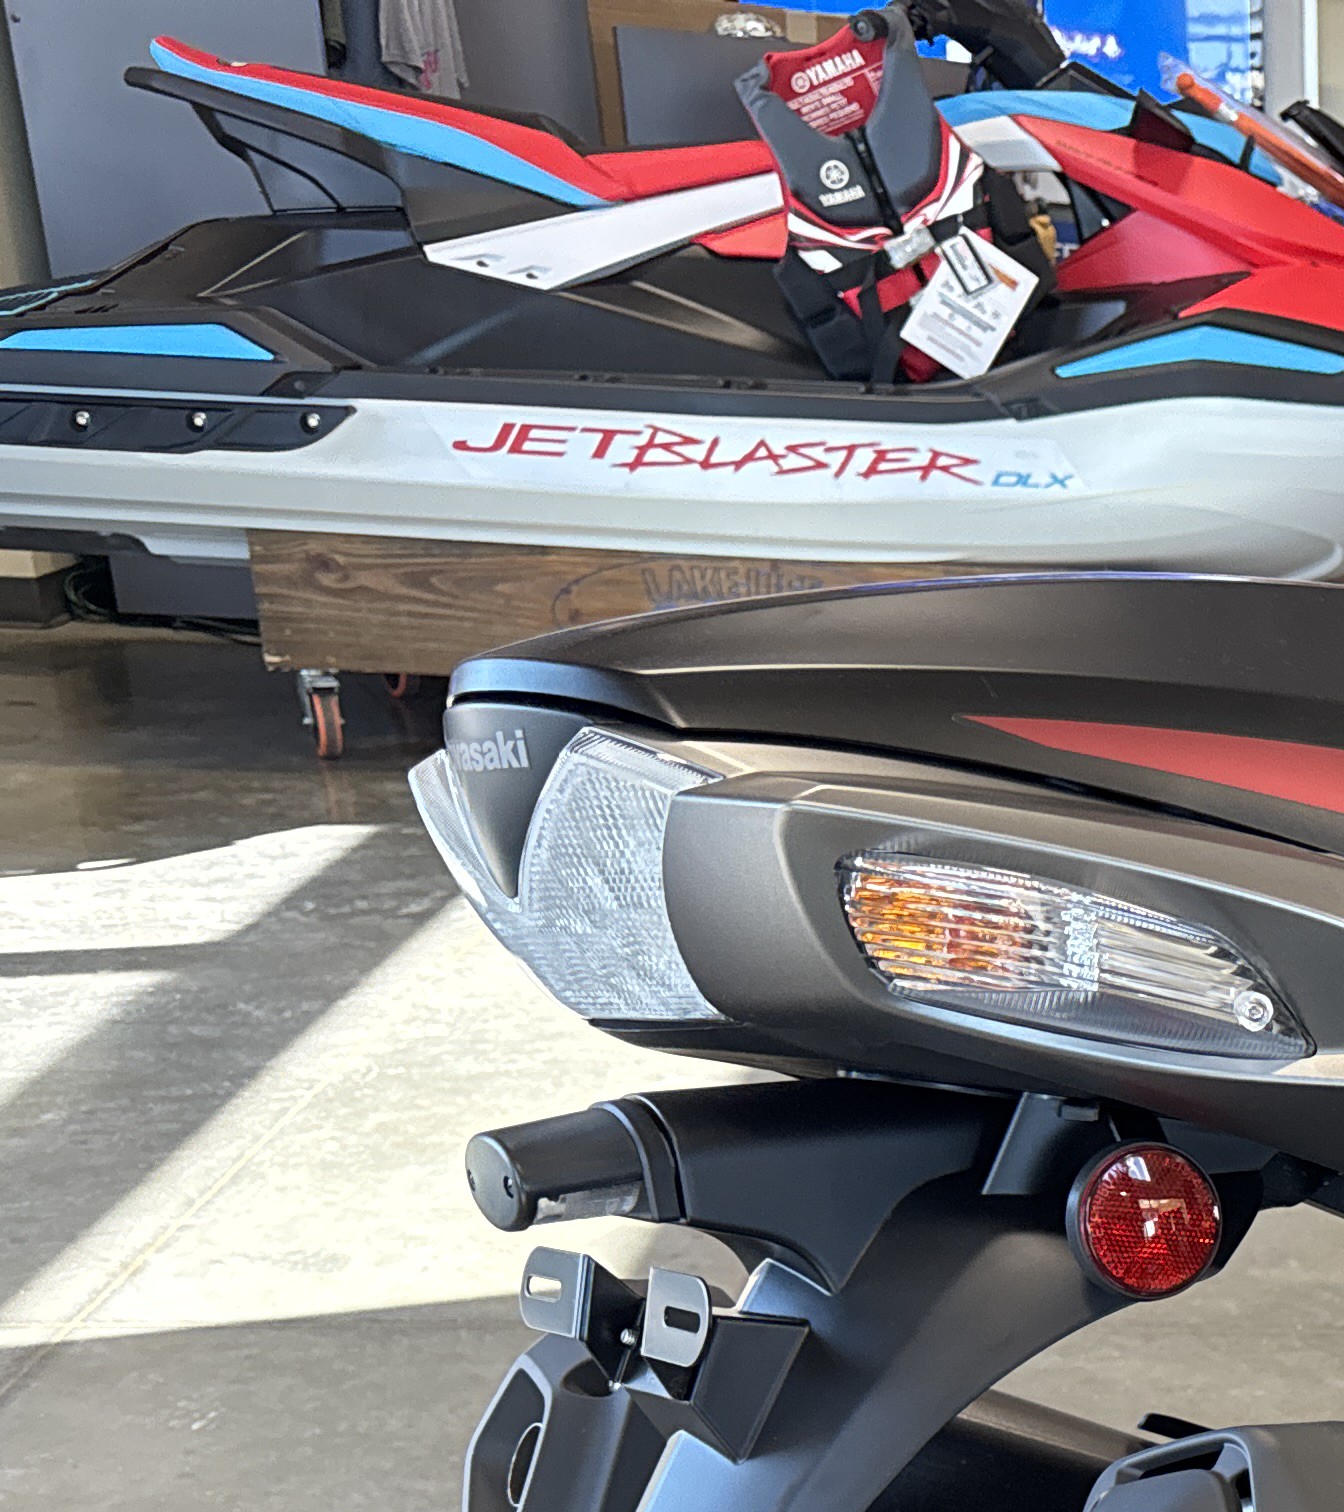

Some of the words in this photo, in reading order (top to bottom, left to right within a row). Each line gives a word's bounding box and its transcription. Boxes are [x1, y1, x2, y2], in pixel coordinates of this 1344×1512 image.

[805, 48, 866, 86] YAMAHA
[451, 421, 985, 487] JETBLASTER
[990, 470, 1076, 490] DLX
